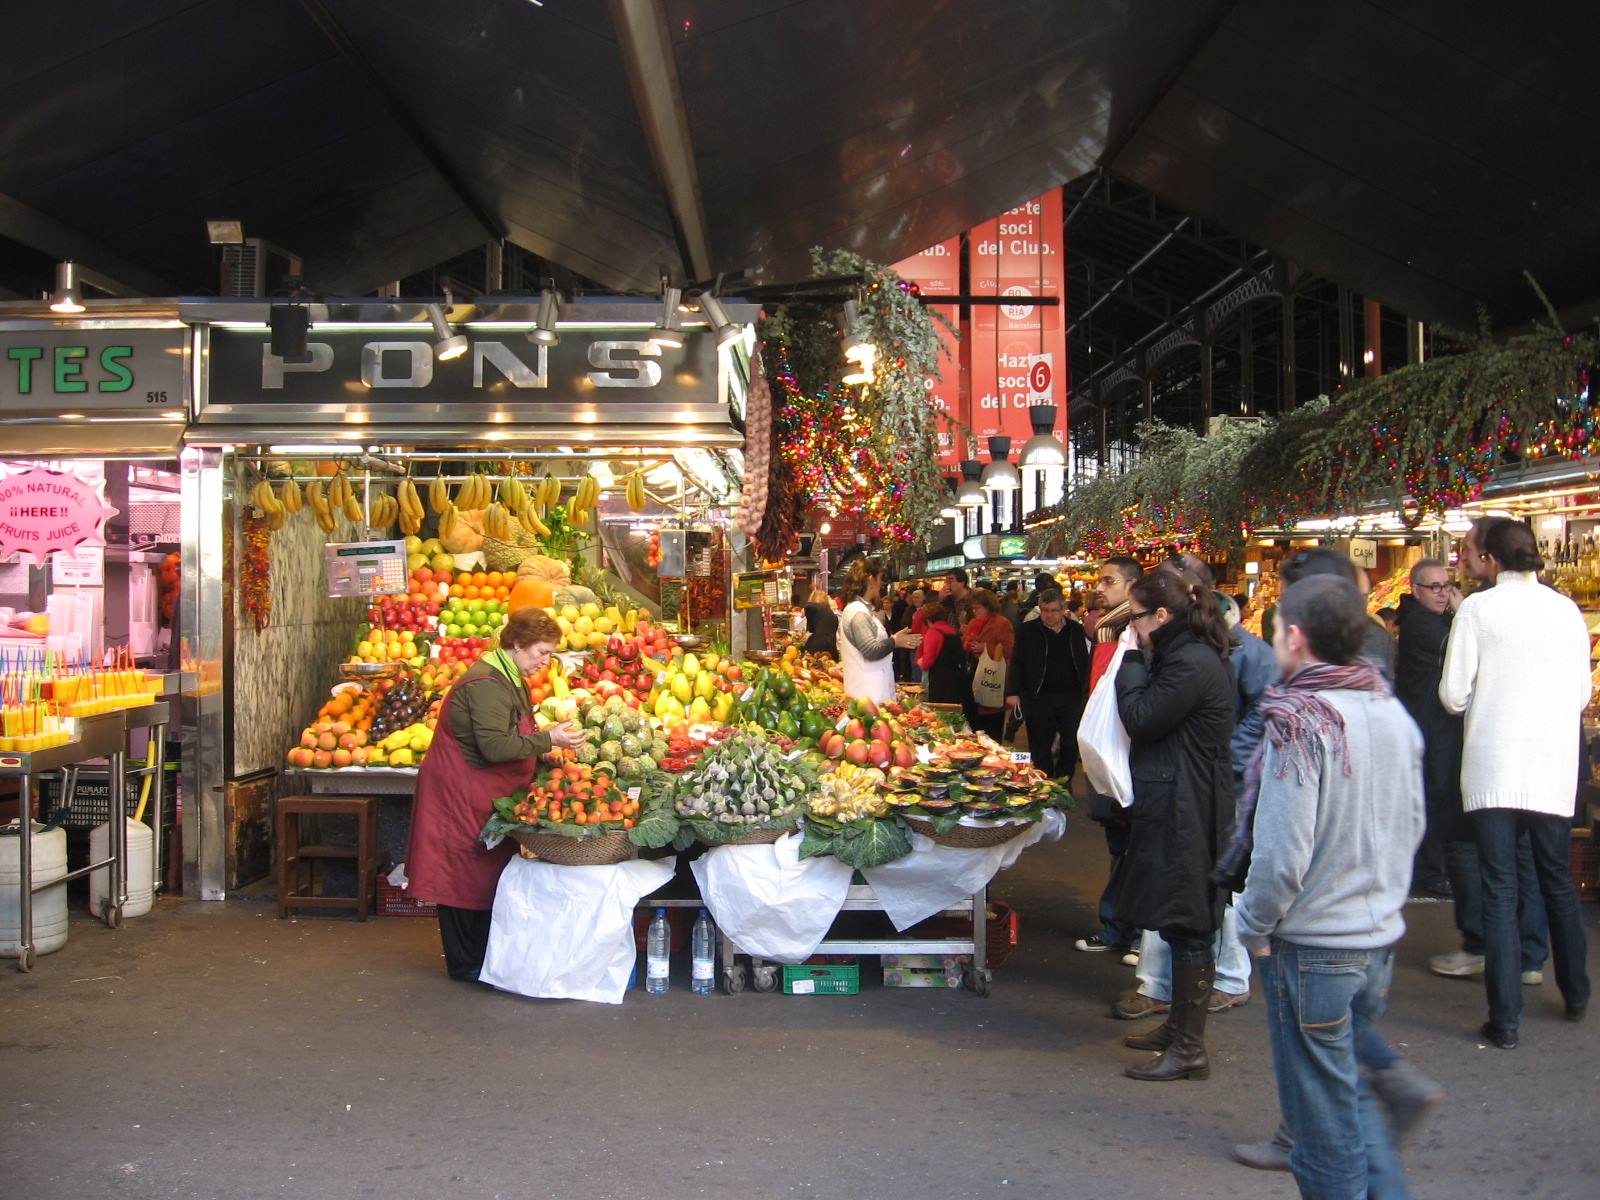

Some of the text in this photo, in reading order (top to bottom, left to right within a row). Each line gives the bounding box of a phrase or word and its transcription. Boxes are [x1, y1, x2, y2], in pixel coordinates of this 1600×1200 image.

[999, 219, 1033, 235] soci
[977, 240, 1004, 256] del
[7, 345, 134, 394] TES
[262, 341, 662, 389] PONS
[1035, 366, 1046, 388] 6
[146, 391, 168, 404] 515
[980, 393, 1007, 409] del
[27, 482, 85, 508] NATURAL
[0, 521, 81, 541] FRUITS JUICE
[1353, 547, 1373, 559] CASH
